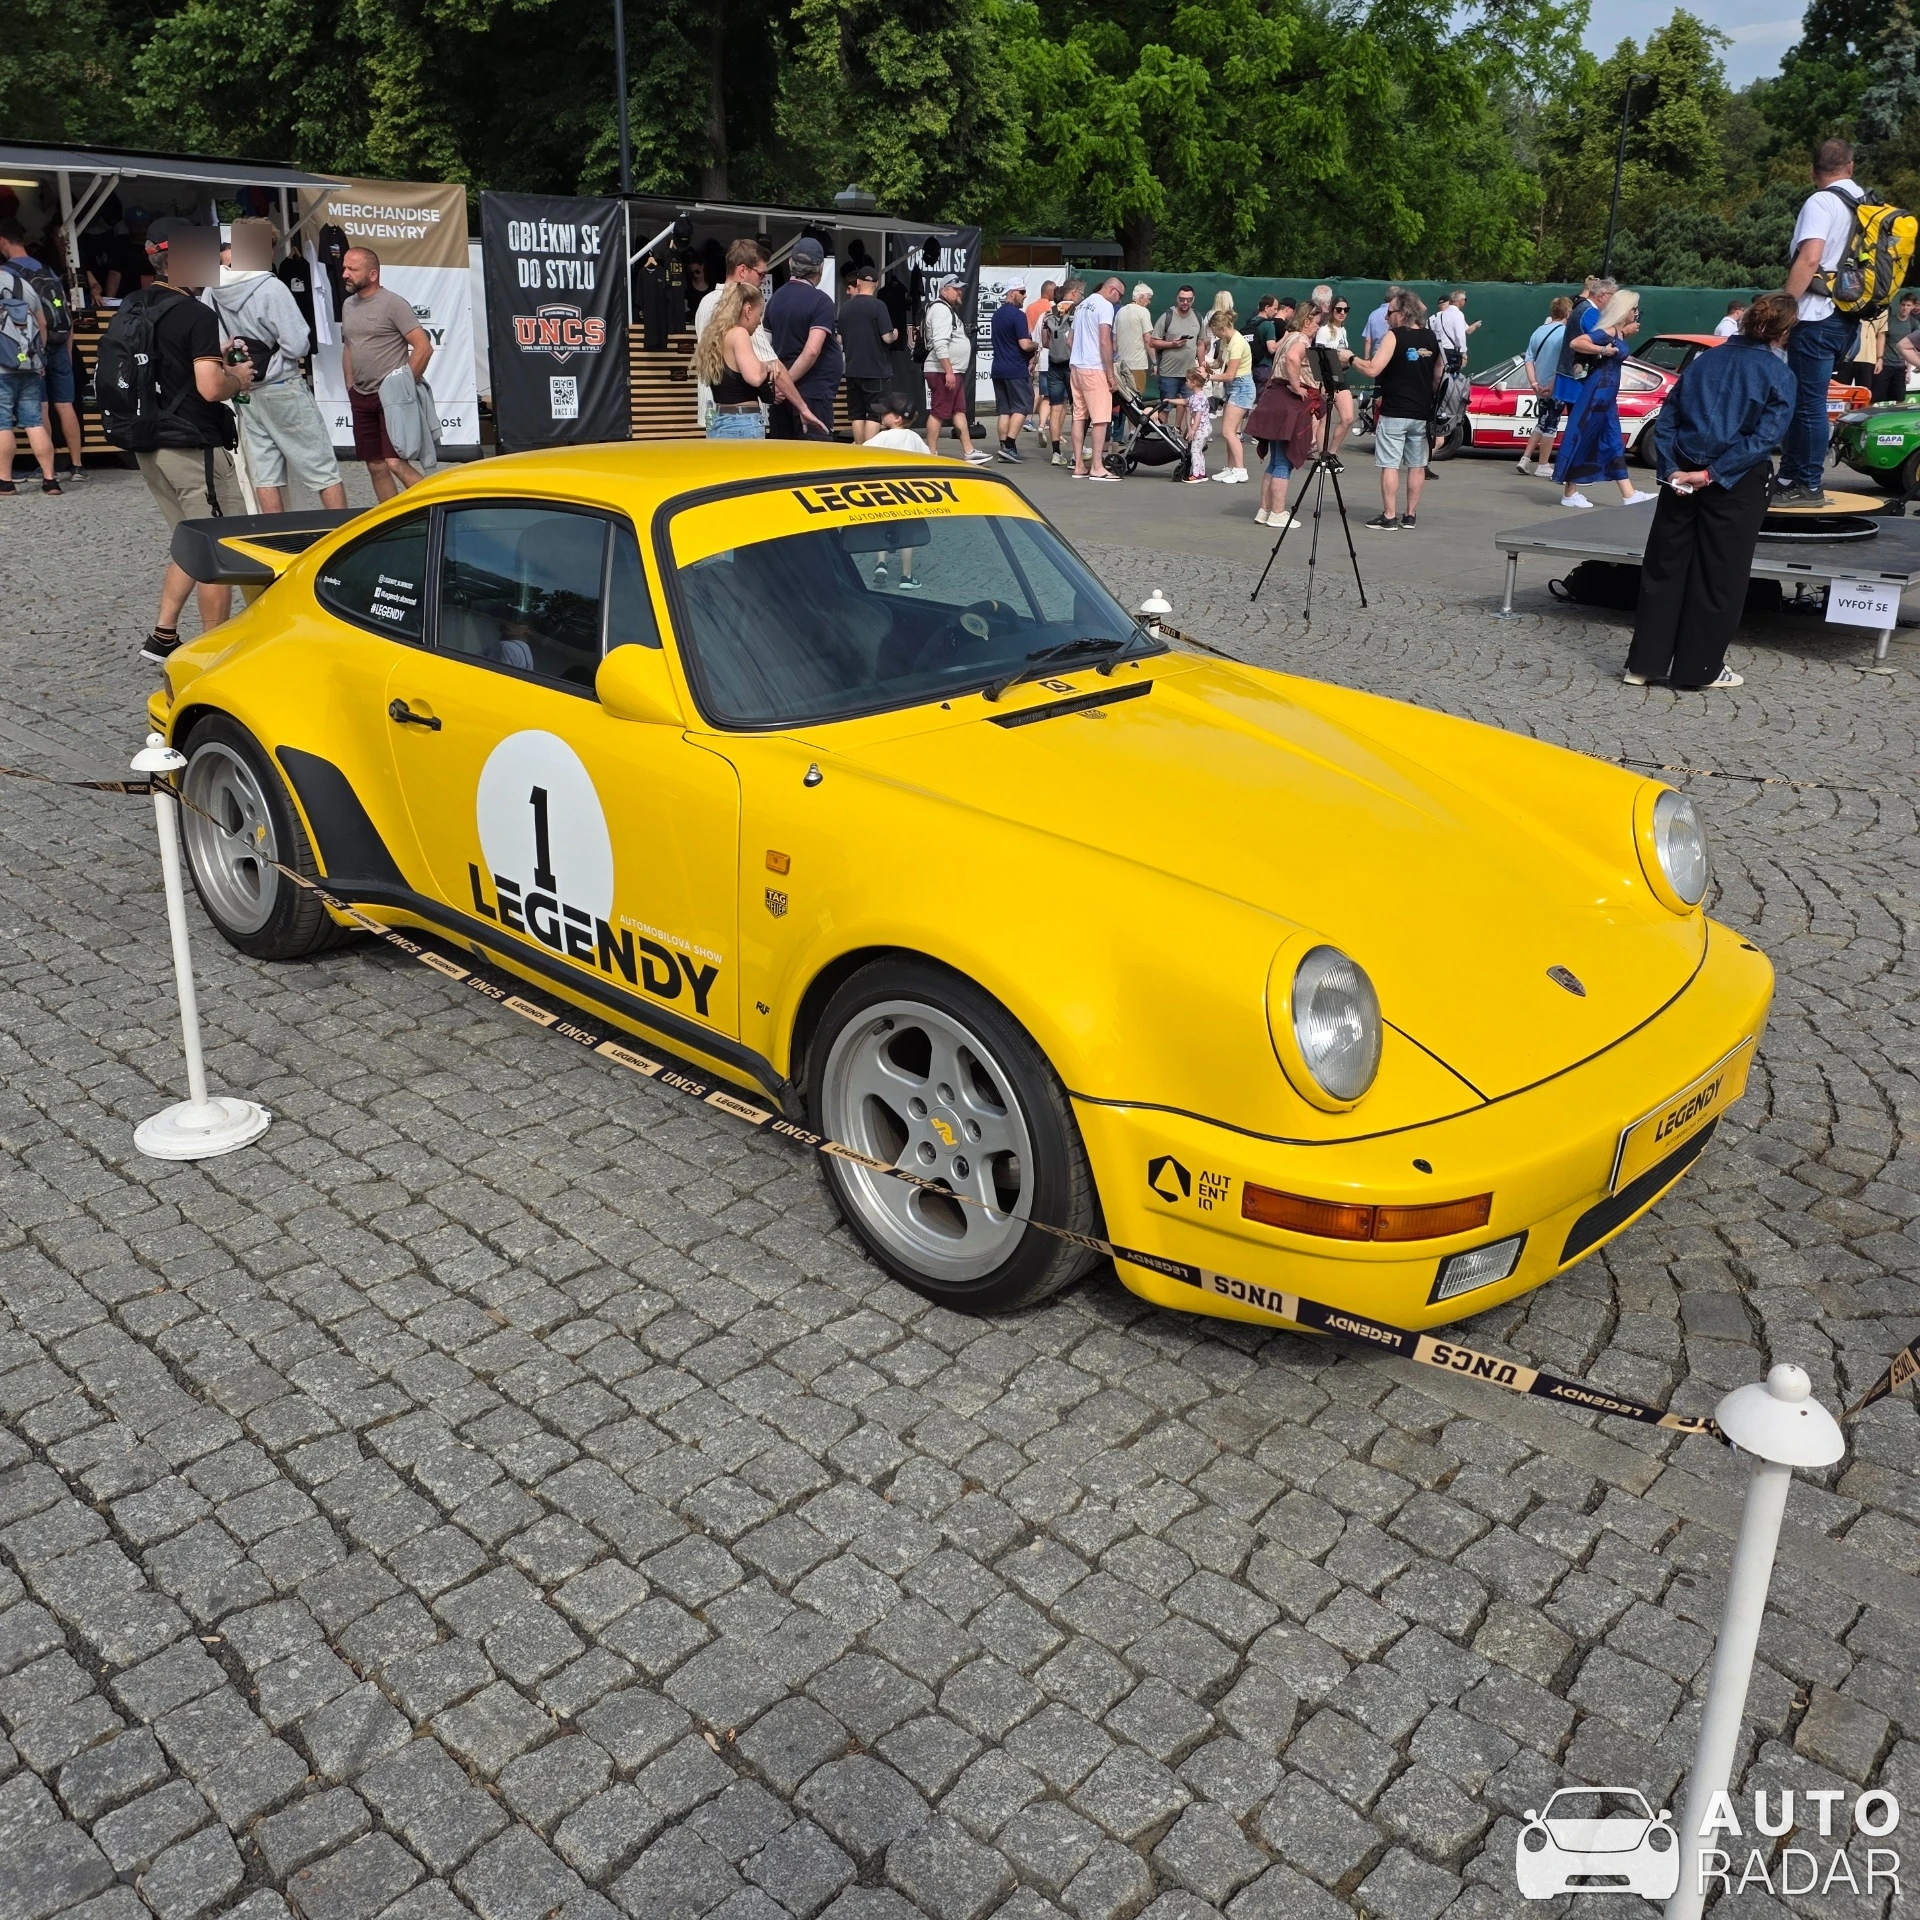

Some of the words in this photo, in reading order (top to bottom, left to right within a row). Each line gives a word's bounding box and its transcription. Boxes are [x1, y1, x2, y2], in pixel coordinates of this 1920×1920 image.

[328, 202, 440, 223] MERCHANDISE
[344, 222, 427, 239] SUVENÝRY
[507, 217, 577, 254] OBLÉKNI
[581, 224, 601, 255] SE
[954, 248, 967, 273] SE
[517, 258, 541, 289] DO
[545, 259, 596, 290] STYLU
[514, 317, 605, 346] UNCS
[554, 408, 577, 416] UNCS.EU
[1878, 435, 1902, 443] GAPA
[791, 481, 961, 515] LEGENDY
[848, 506, 923, 522] AUTOMOBILOVÁ
[925, 507, 952, 515] SHOW
[370, 603, 406, 622] #LEGENDY
[1838, 598, 1874, 611] VYFOŤ
[1875, 602, 1889, 613] SE
[1670, 766, 1704, 775] UNCS
[529, 785, 557, 894] 1
[767, 890, 786, 904] TAG
[766, 900, 786, 916] HEUER
[468, 862, 719, 1018] LEGENDY
[619, 914, 691, 951] AUTOMOBILOVÁ
[693, 944, 723, 964] SHOW
[1654, 1073, 1725, 1143] LEGENDY
[313, 889, 347, 909] UNCS
[350, 911, 381, 929] LEGENDY
[385, 933, 421, 954] UNCS
[426, 955, 461, 976] LEGENDY
[466, 977, 506, 999] UNCS
[511, 1000, 547, 1021] LEGENDY
[556, 1022, 598, 1046] UNCS
[611, 1049, 652, 1071] LEGENDY
[661, 1071, 707, 1097] UNCS
[715, 1096, 760, 1119] LEGENDY
[771, 1120, 822, 1145] UNCS
[832, 1146, 883, 1168] LEGENDY
[896, 1172, 953, 1194] UNCS
[1127, 1251, 1189, 1278] LEGENDY
[1214, 1275, 1284, 1314] UNCS
[1325, 1313, 1403, 1348] LEGENDY
[1431, 1344, 1518, 1386] UNCS
[1551, 1383, 1644, 1417] LEGENDY
[1200, 1170, 1231, 1189] AUT
[1198, 1183, 1228, 1202] ENT
[1893, 1353, 1916, 1384] UNCS
